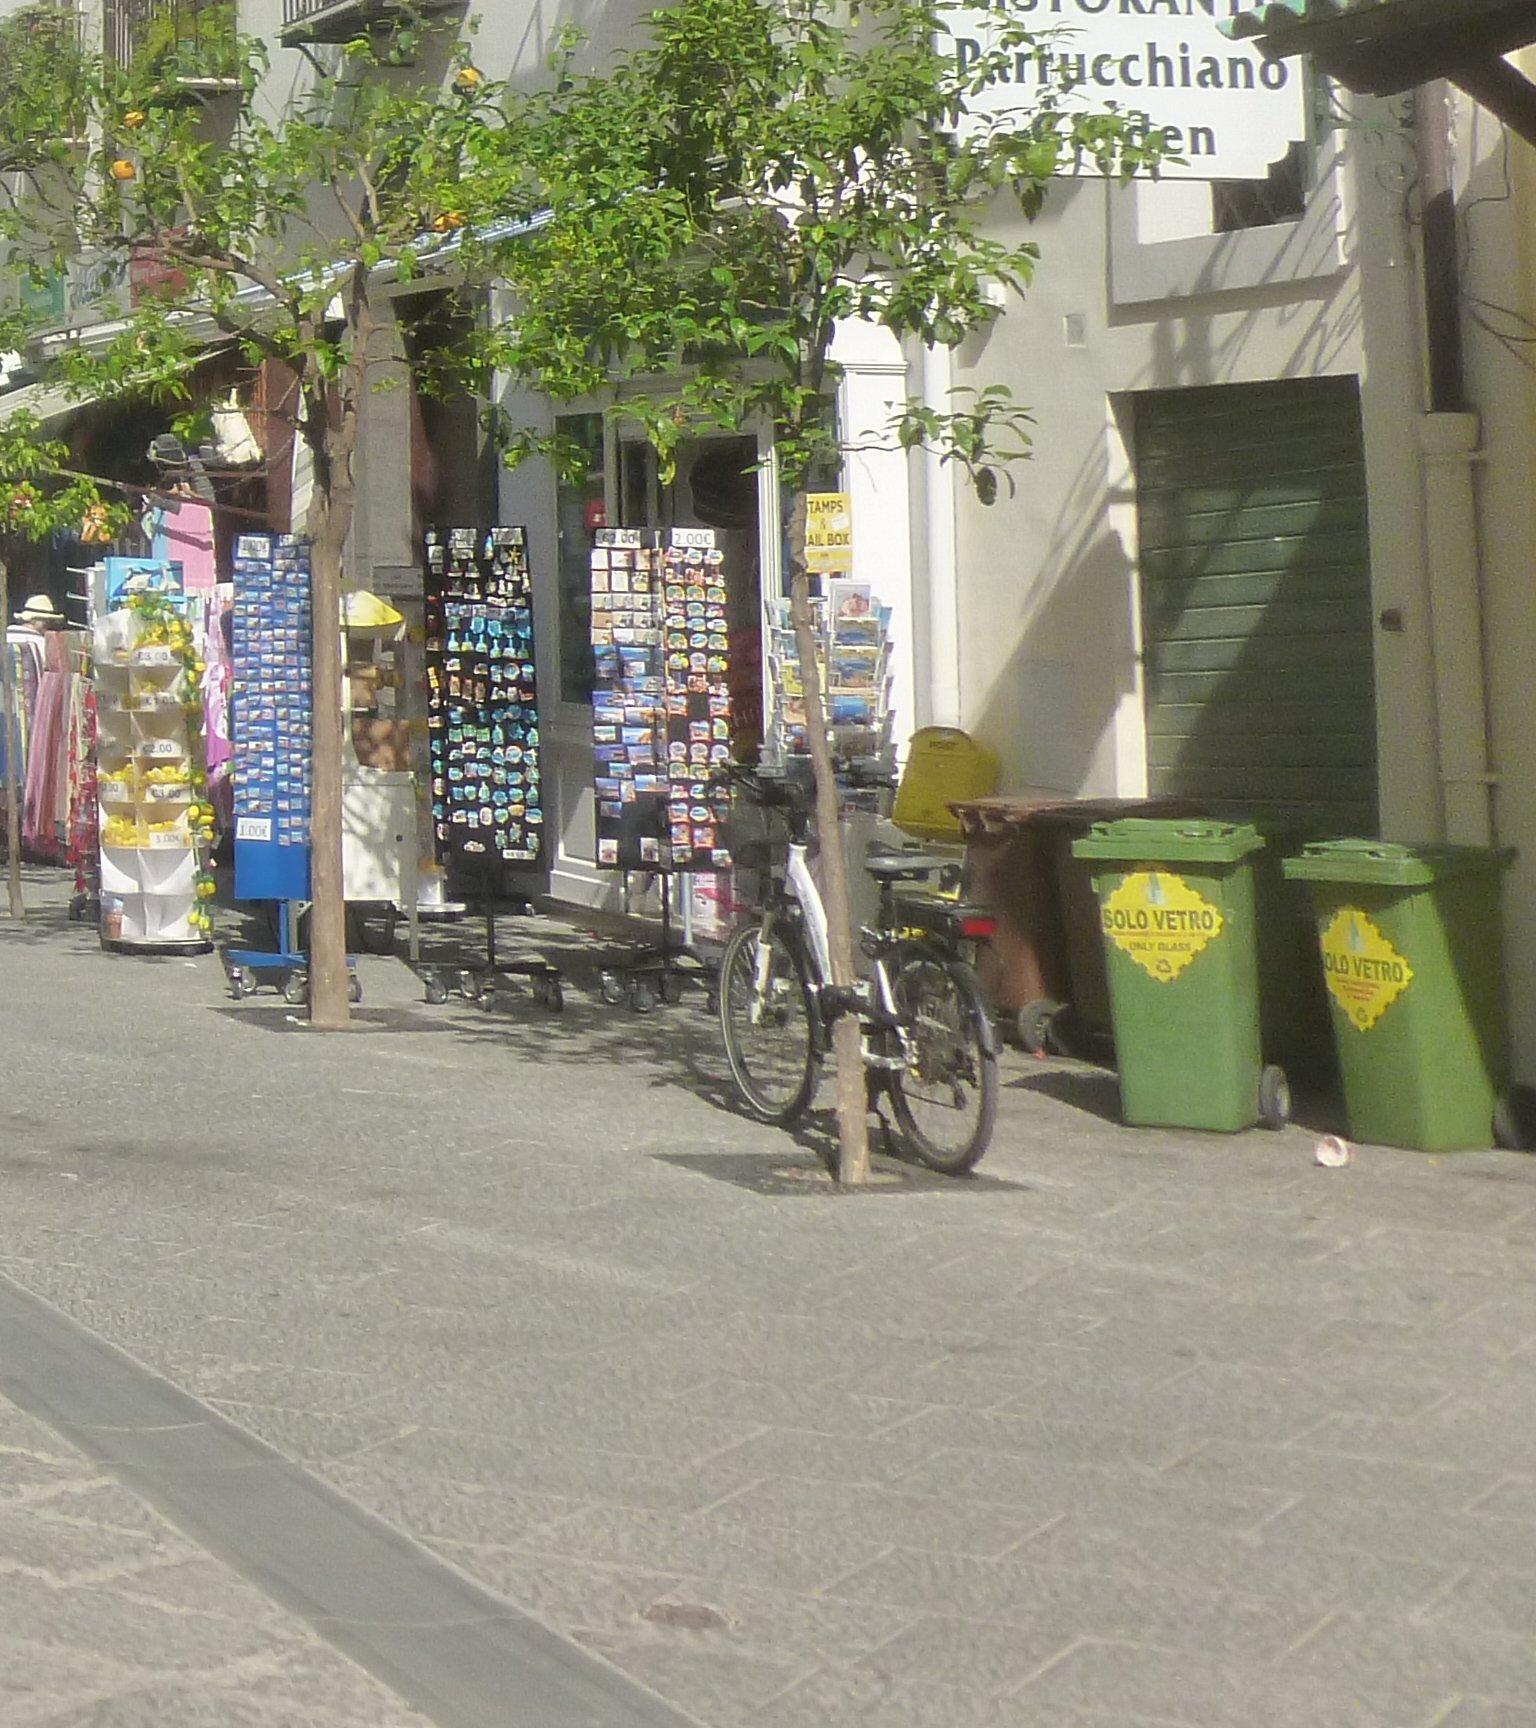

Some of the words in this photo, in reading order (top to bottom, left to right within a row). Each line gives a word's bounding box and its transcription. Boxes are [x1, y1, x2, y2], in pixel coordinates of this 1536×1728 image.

[955, 37, 1290, 90] Parrucchiano
[808, 500, 844, 514] TAMPS
[675, 532, 713, 546] 2.00€
[808, 533, 825, 547] AIL
[827, 532, 850, 546] BOX
[1102, 908, 1148, 930] SOLO
[1151, 909, 1214, 931] VETRO
[1324, 951, 1350, 975] OLO
[1353, 955, 1404, 983] VETRO
